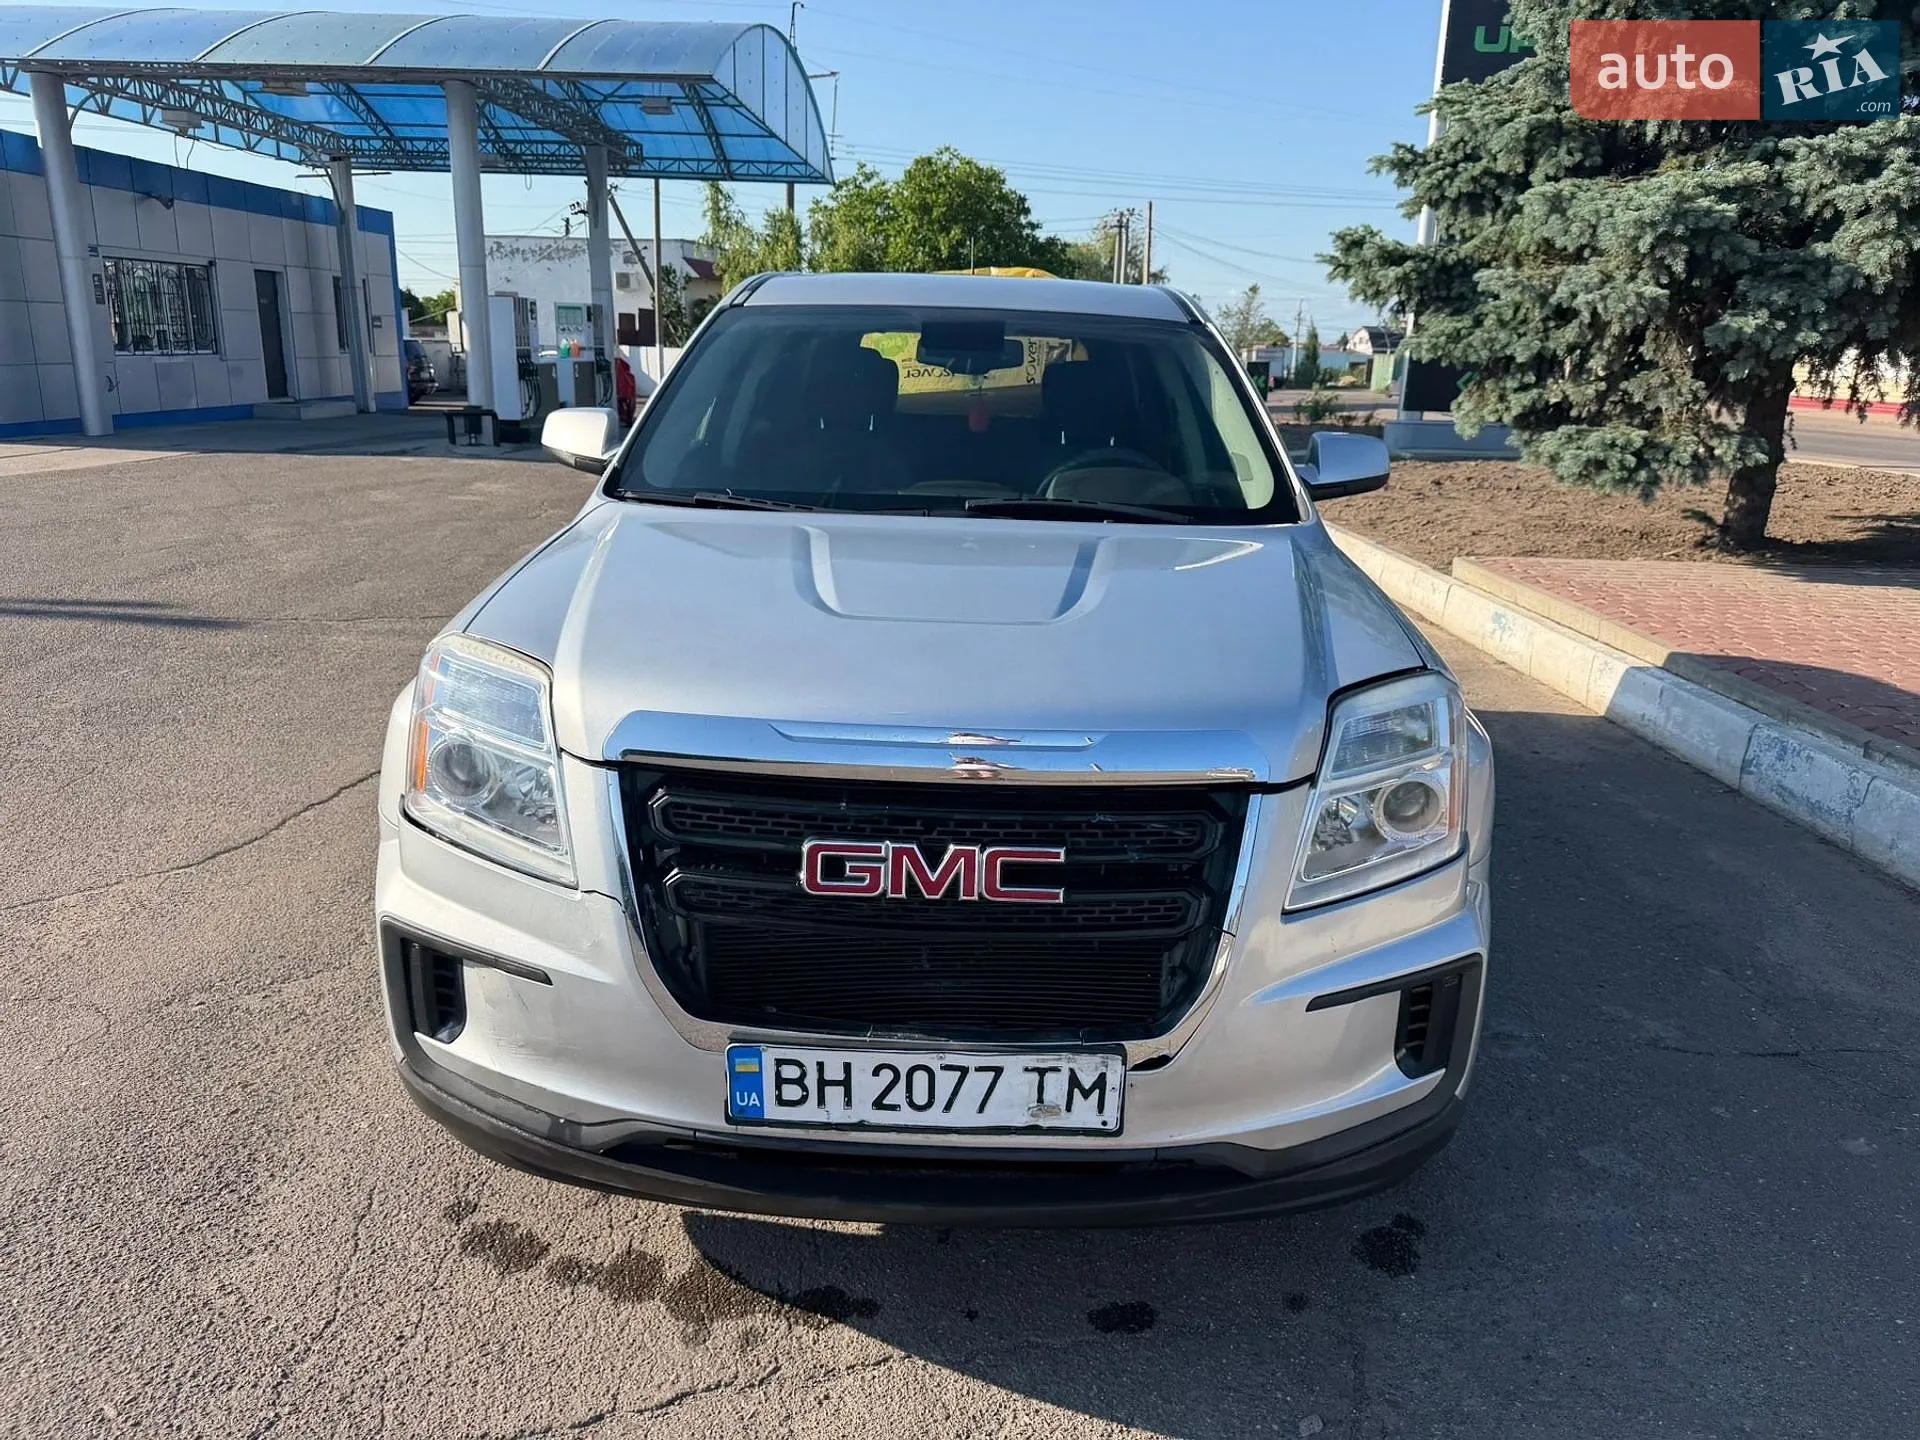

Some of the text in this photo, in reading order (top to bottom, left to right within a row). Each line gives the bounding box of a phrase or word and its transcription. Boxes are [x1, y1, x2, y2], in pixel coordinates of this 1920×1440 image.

[801, 839, 1065, 903] GMC
[736, 1091, 761, 1108] UA
[773, 1057, 1107, 1116] BH 2077 TM
